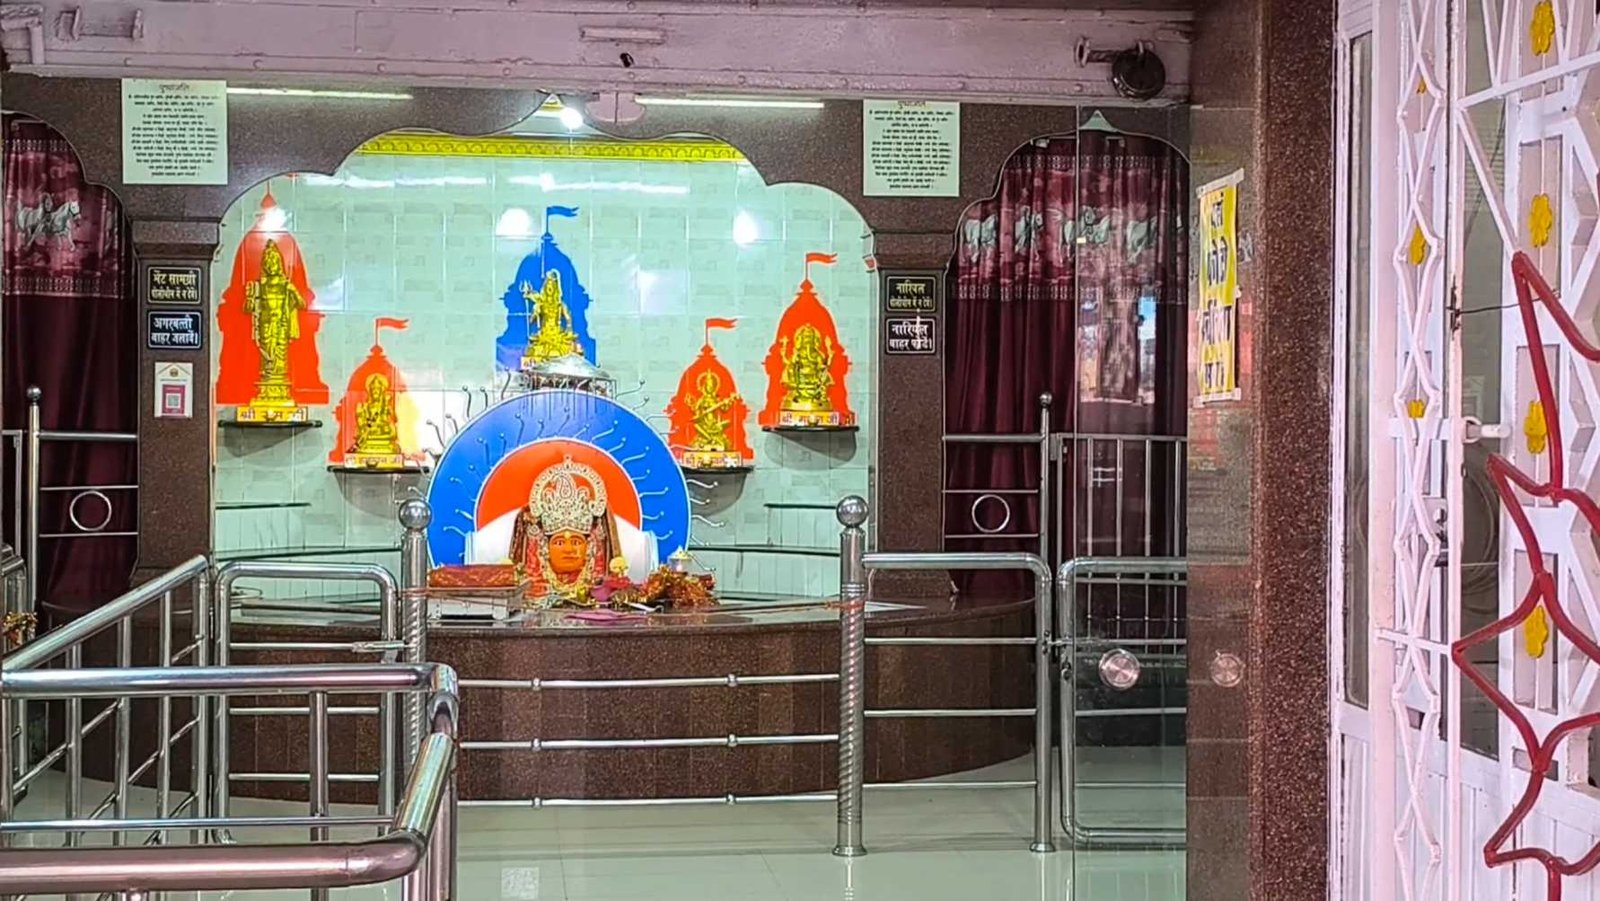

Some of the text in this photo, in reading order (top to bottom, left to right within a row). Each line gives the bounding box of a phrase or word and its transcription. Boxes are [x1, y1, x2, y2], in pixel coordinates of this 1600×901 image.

[168, 270, 197, 286] सामग्री
[896, 279, 926, 296] नारियल
[891, 321, 928, 337] नारियल
[151, 332, 171, 345] बाहर
[889, 339, 910, 351] बाहर
